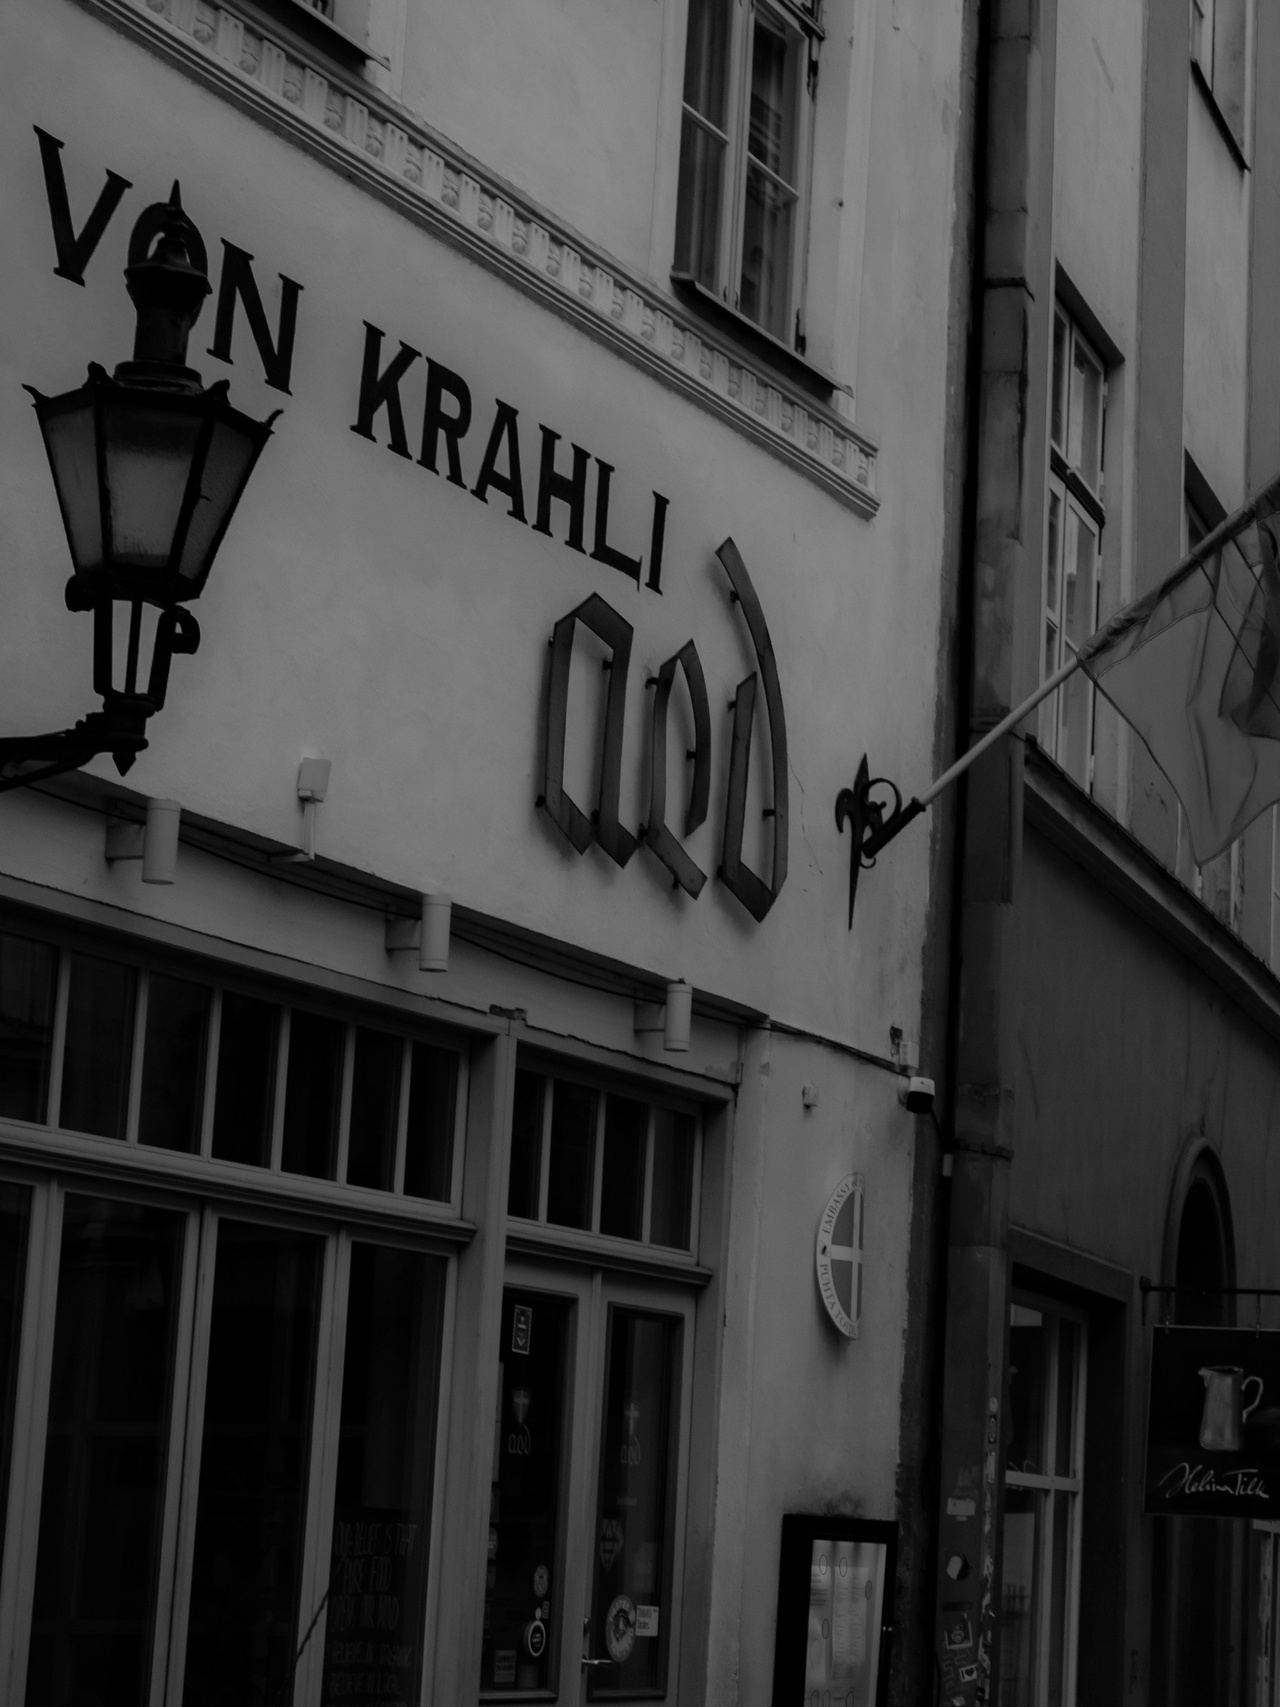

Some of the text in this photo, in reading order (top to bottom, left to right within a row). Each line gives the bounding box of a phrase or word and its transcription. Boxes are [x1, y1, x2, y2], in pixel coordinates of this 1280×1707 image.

[350, 320, 670, 595] KRAHLI
[822, 1182, 850, 1234] EMBASSY
[819, 1264, 837, 1311] PUHTA
[1222, 1469, 1270, 1499] Tilk
